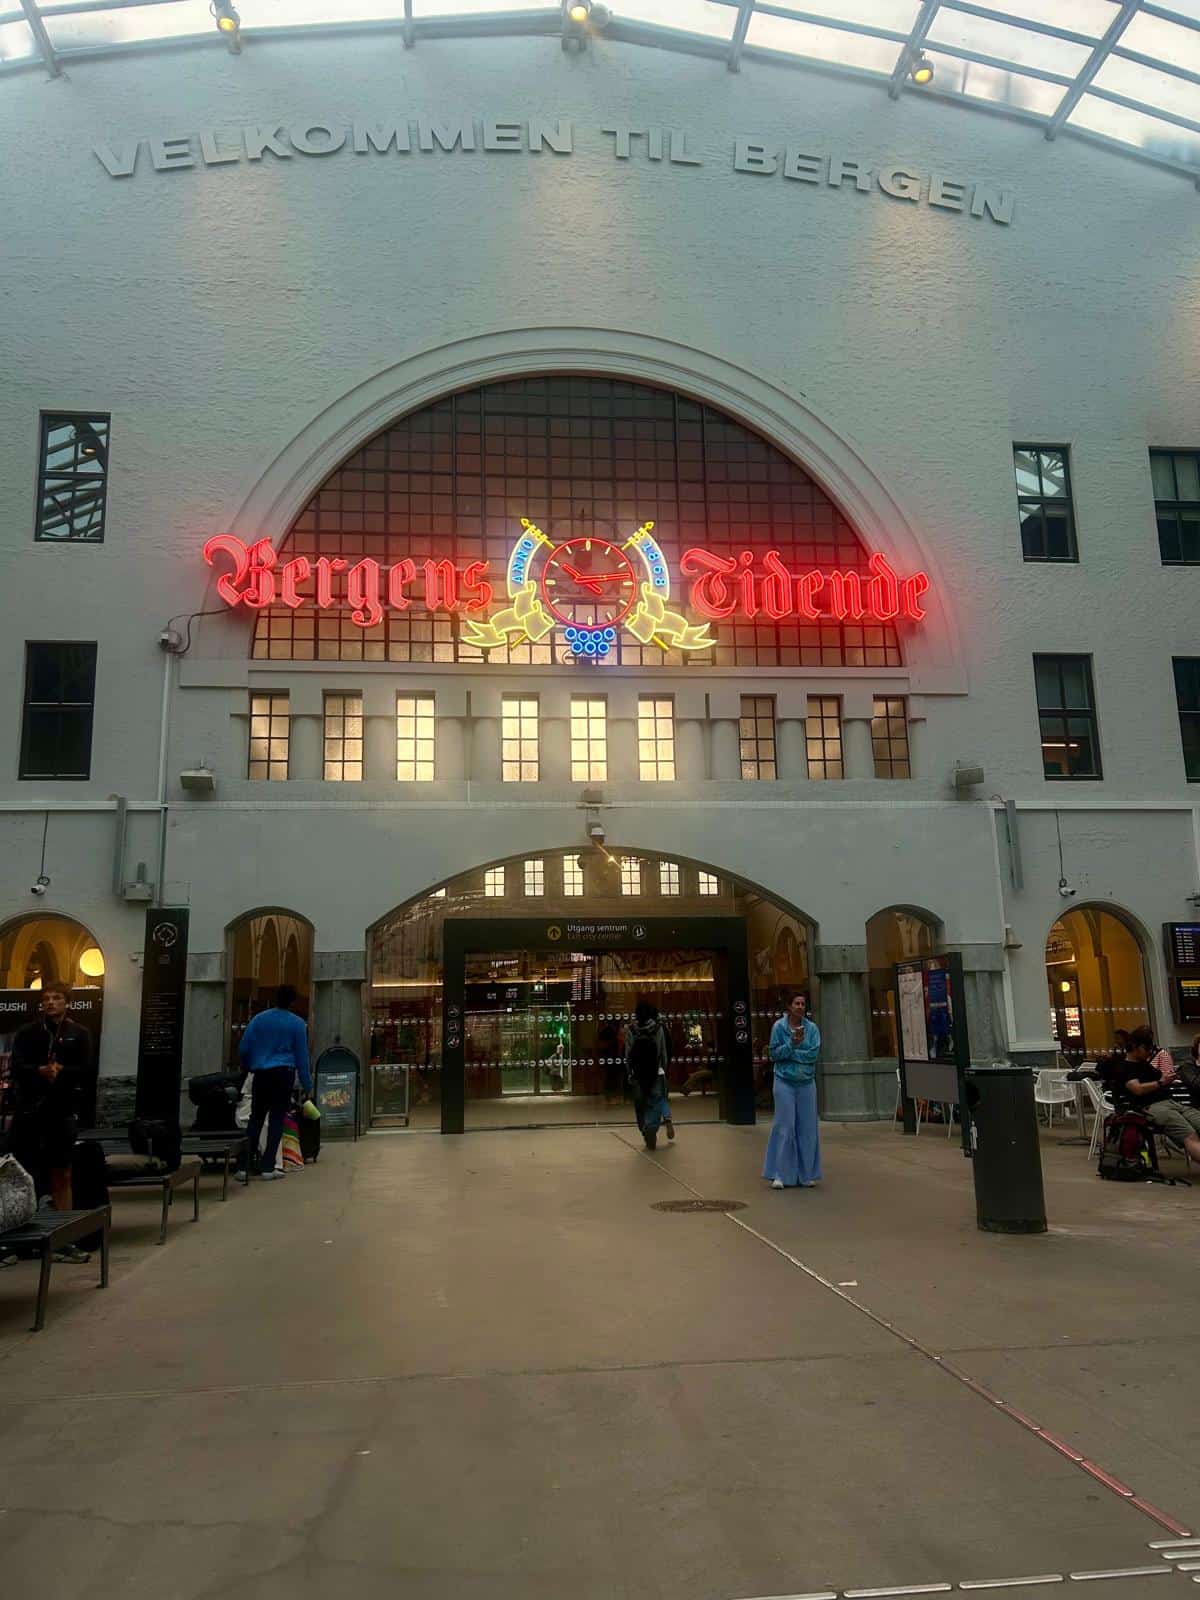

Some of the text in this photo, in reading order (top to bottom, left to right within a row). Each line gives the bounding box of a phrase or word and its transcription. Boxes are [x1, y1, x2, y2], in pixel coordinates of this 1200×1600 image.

[93, 118, 1015, 226] VELKOMMEN TIL BERGEN
[203, 534, 930, 627] Bergens Tidende
[511, 539, 535, 585] ANNO
[641, 542, 667, 587] 1868
[567, 924, 595, 933] Utgang
